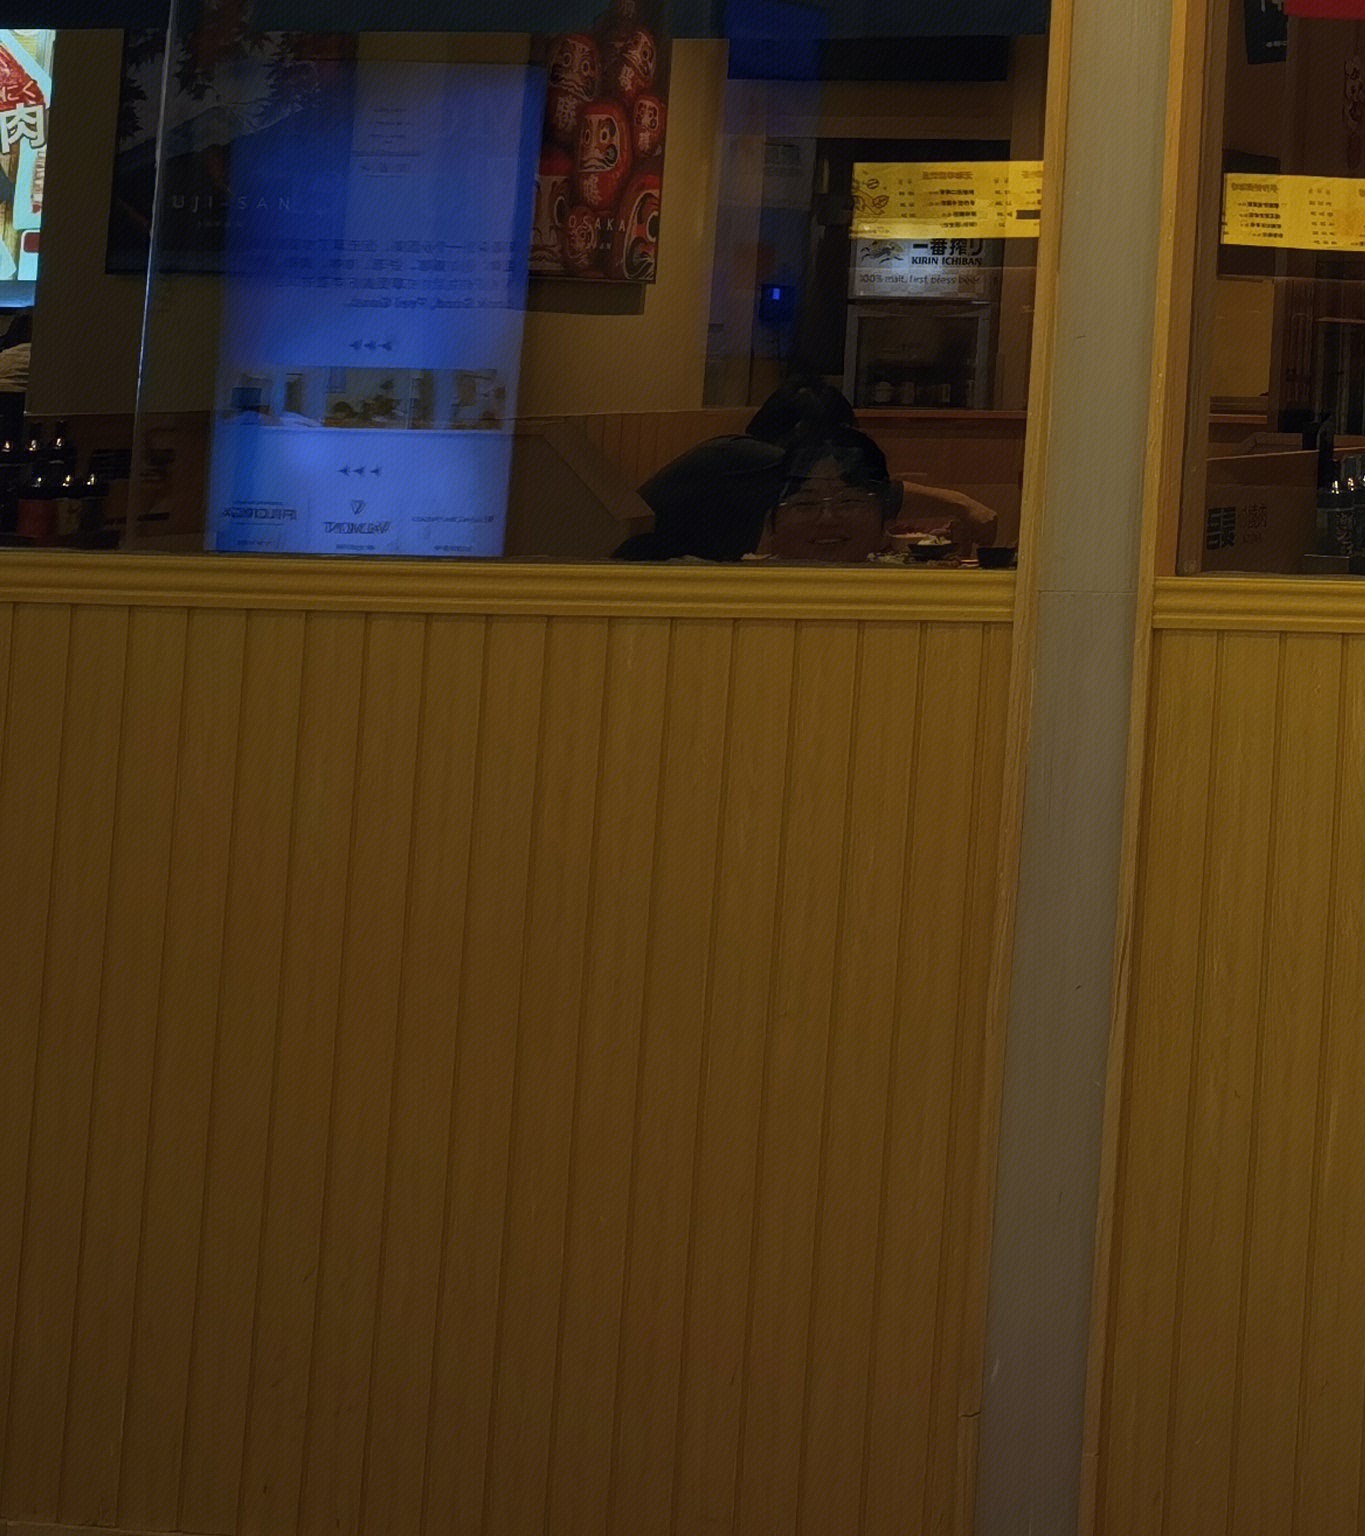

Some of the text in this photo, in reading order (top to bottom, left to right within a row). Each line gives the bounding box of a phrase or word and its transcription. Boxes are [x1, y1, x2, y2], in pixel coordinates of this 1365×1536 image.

[568, 215, 627, 232] OSAKA
[911, 256, 983, 266] KIRIN ICHIBAN
